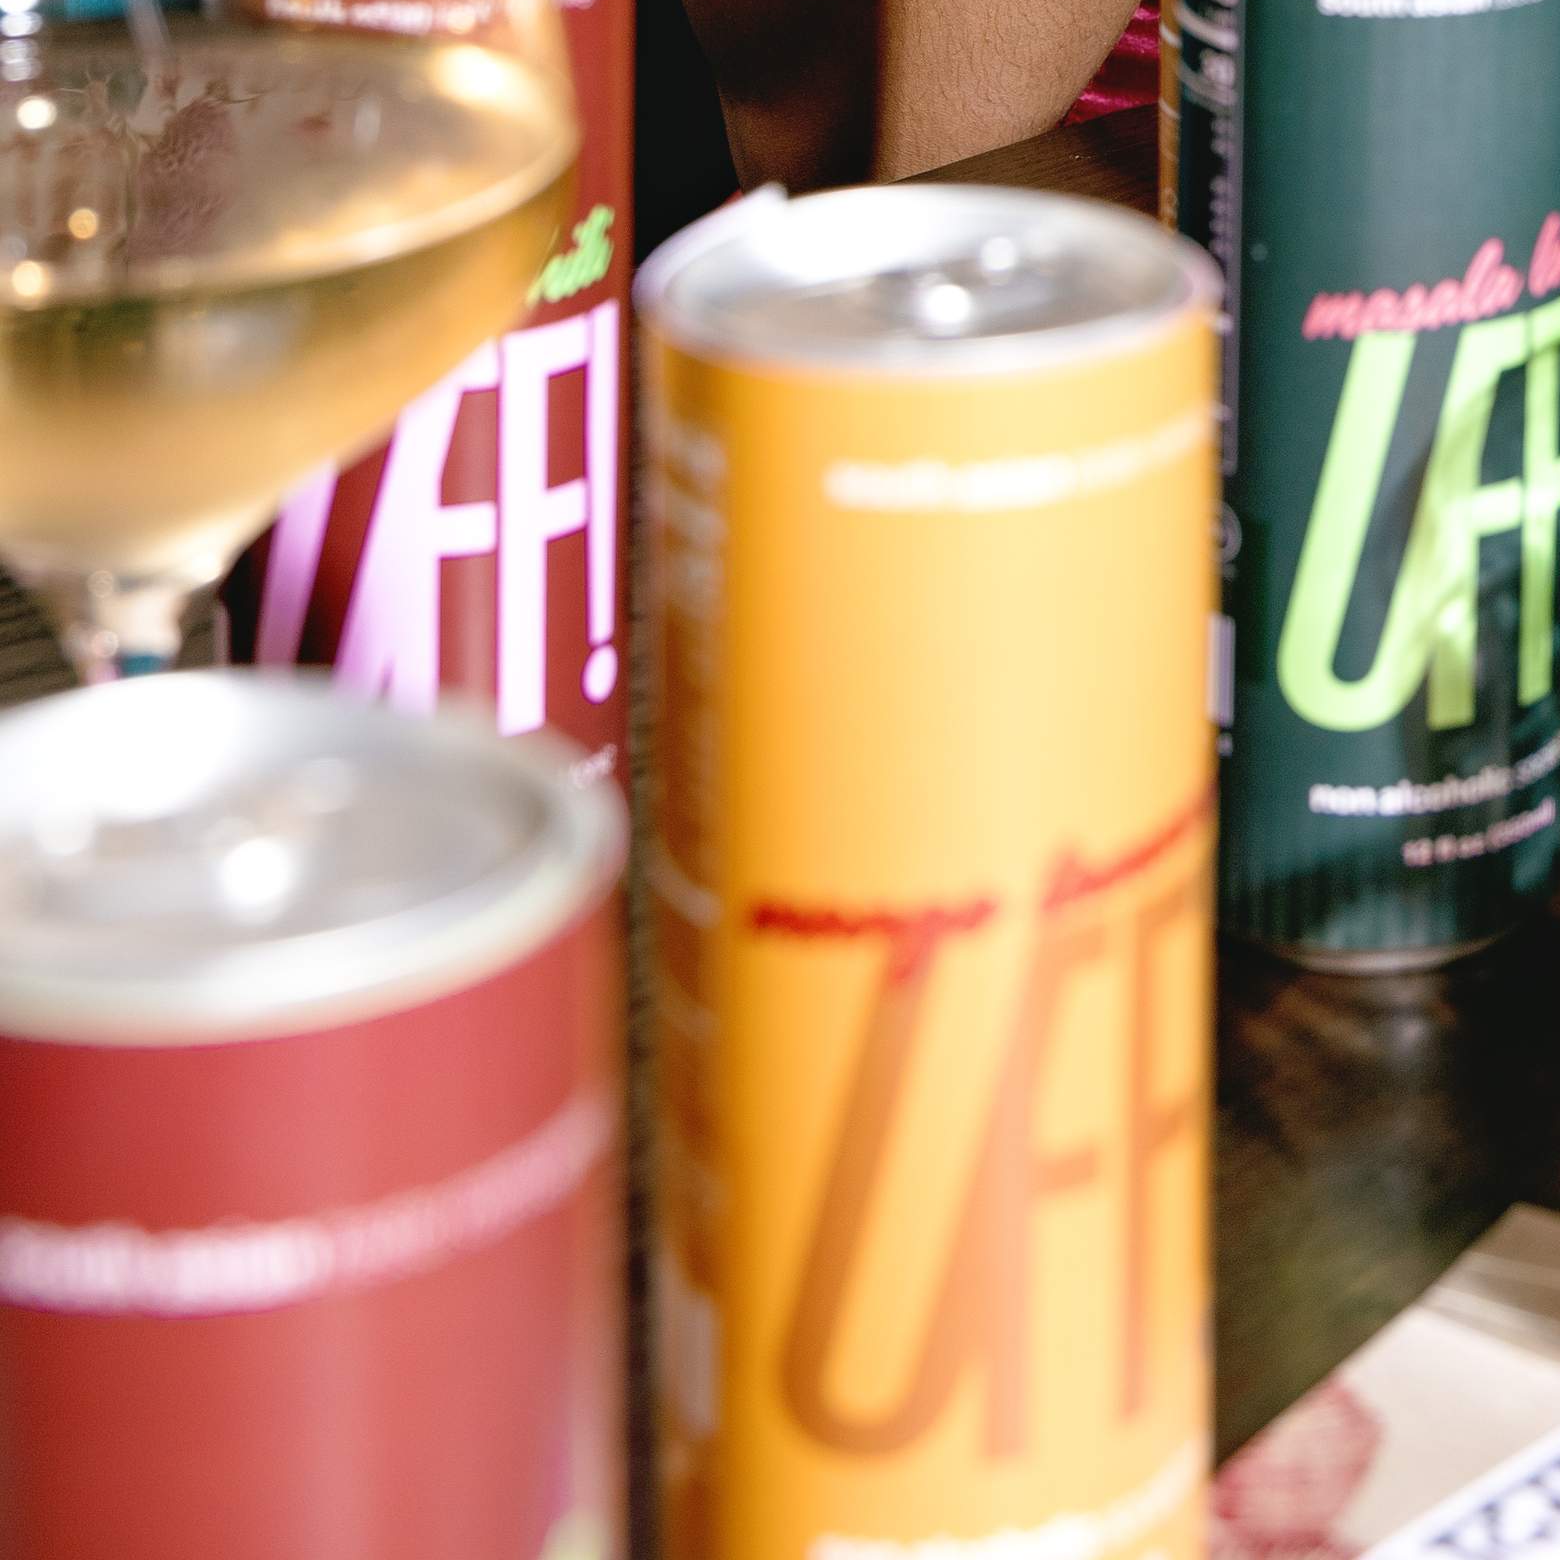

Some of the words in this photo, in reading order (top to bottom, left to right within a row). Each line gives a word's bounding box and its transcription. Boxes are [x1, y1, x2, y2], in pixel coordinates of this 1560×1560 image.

[1301, 236, 1525, 341] masala
[1308, 782, 1376, 816] non
[1377, 764, 1512, 816] alcoholic
